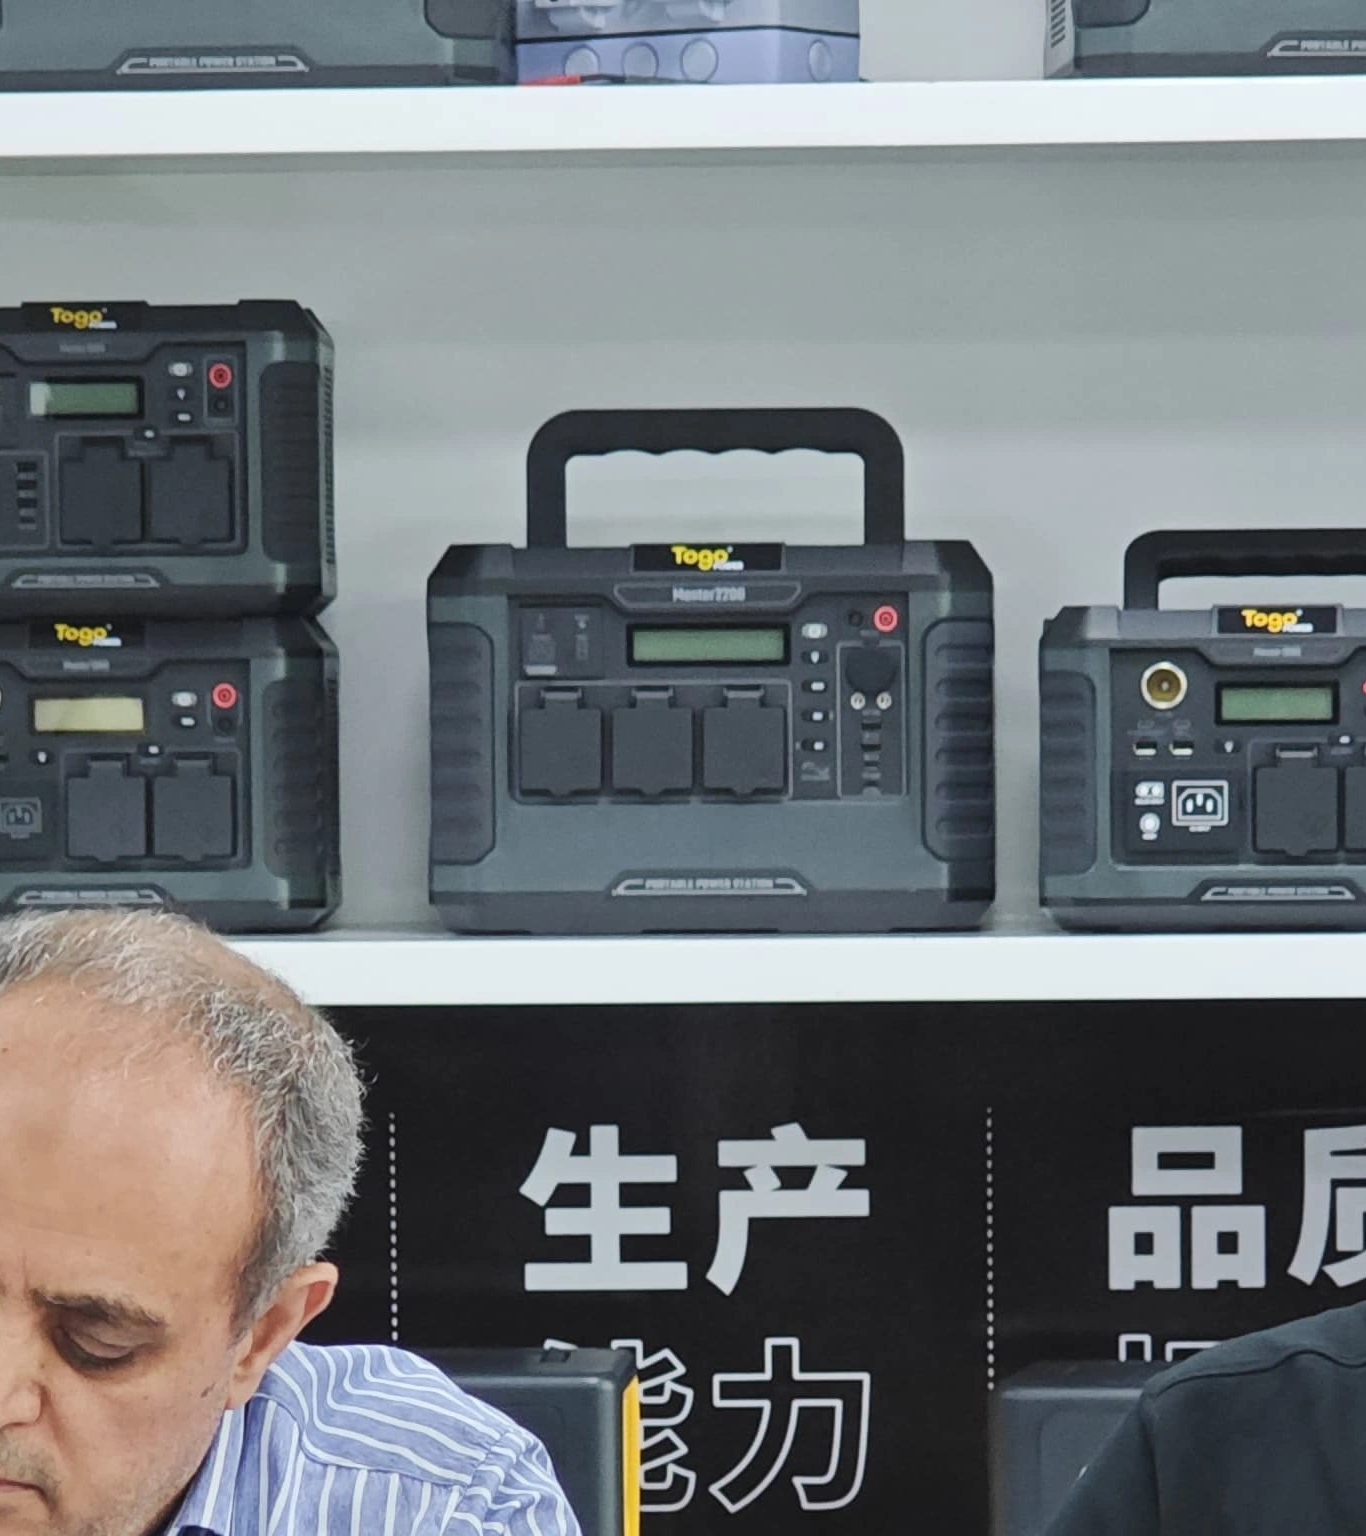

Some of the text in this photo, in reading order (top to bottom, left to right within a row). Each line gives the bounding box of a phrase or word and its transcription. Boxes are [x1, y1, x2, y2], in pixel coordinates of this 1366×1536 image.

[50, 307, 103, 329] Togo
[671, 546, 728, 571] Togo
[1241, 609, 1297, 633] Togo
[54, 623, 107, 646] Togo
[519, 1122, 870, 1296] 生产
